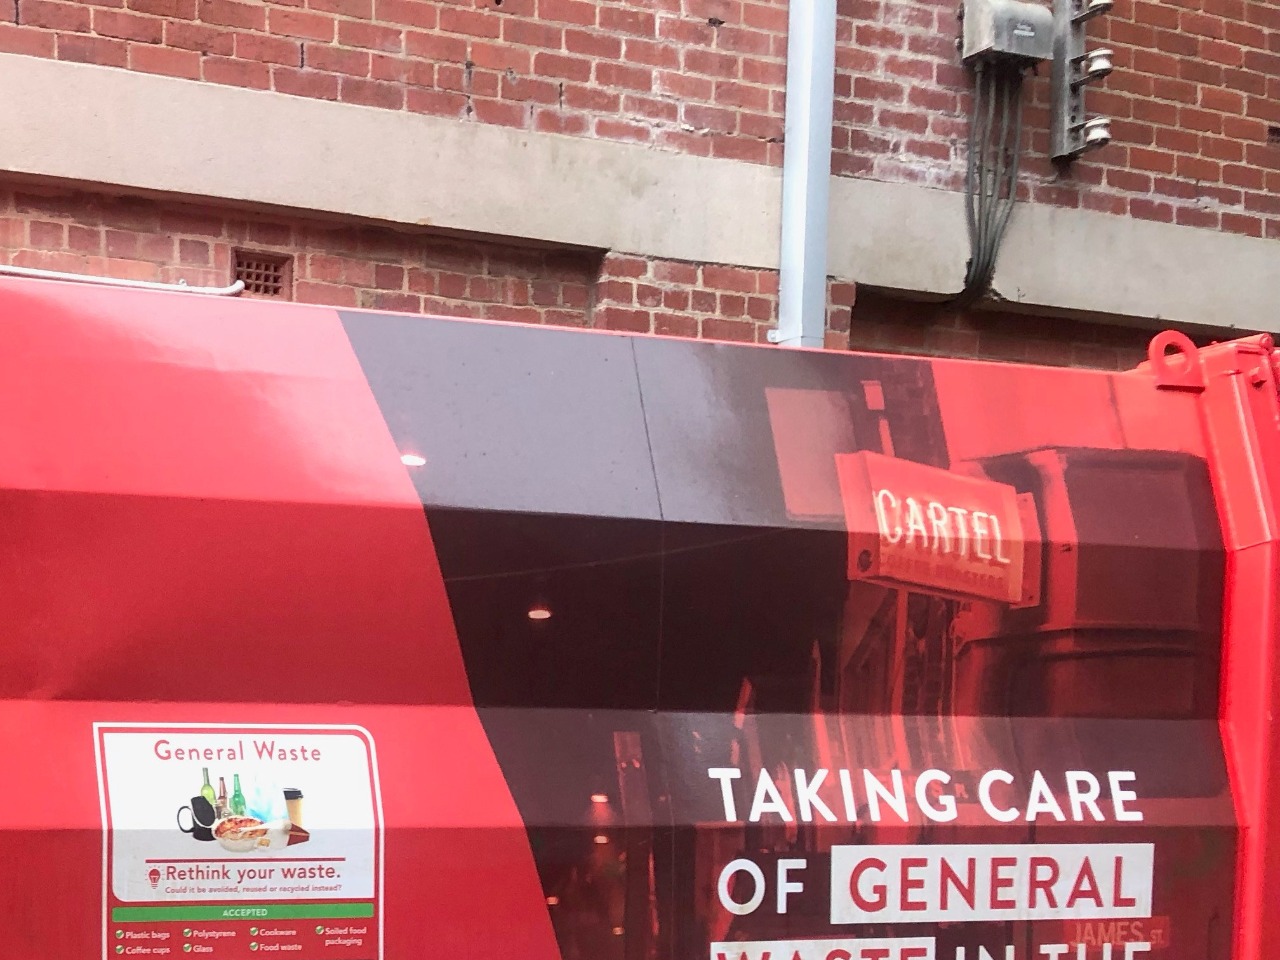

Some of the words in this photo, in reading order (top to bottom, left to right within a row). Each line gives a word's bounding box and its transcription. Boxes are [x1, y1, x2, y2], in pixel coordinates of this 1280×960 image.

[874, 489, 1011, 564] CARTEL
[154, 739, 244, 761] General
[253, 740, 321, 762] Waste
[707, 767, 959, 823] TAKING
[978, 768, 1144, 823] CARE
[166, 865, 231, 881] Rethink
[237, 868, 275, 884] your
[281, 864, 341, 879] waste.
[165, 886, 187, 894] Could
[242, 885, 268, 893] reused
[279, 884, 310, 893] recycled
[312, 884, 342, 892] instead?
[717, 857, 808, 916] OF
[849, 855, 1137, 913] GENERAL
[223, 908, 268, 917] ACCEPTED
[193, 929, 236, 939] Polystyrene
[260, 928, 297, 936] Cookware
[325, 926, 348, 935] Soiled
[349, 926, 367, 934] food
[1070, 920, 1144, 947] JAMES
[125, 931, 150, 939] Plastic
[151, 931, 170, 940] bags
[325, 937, 363, 946] packaging
[125, 946, 151, 955] Coffee
[152, 947, 171, 955] cups
[193, 944, 214, 953] Glass
[260, 943, 279, 951] Food
[281, 943, 302, 951] waste
